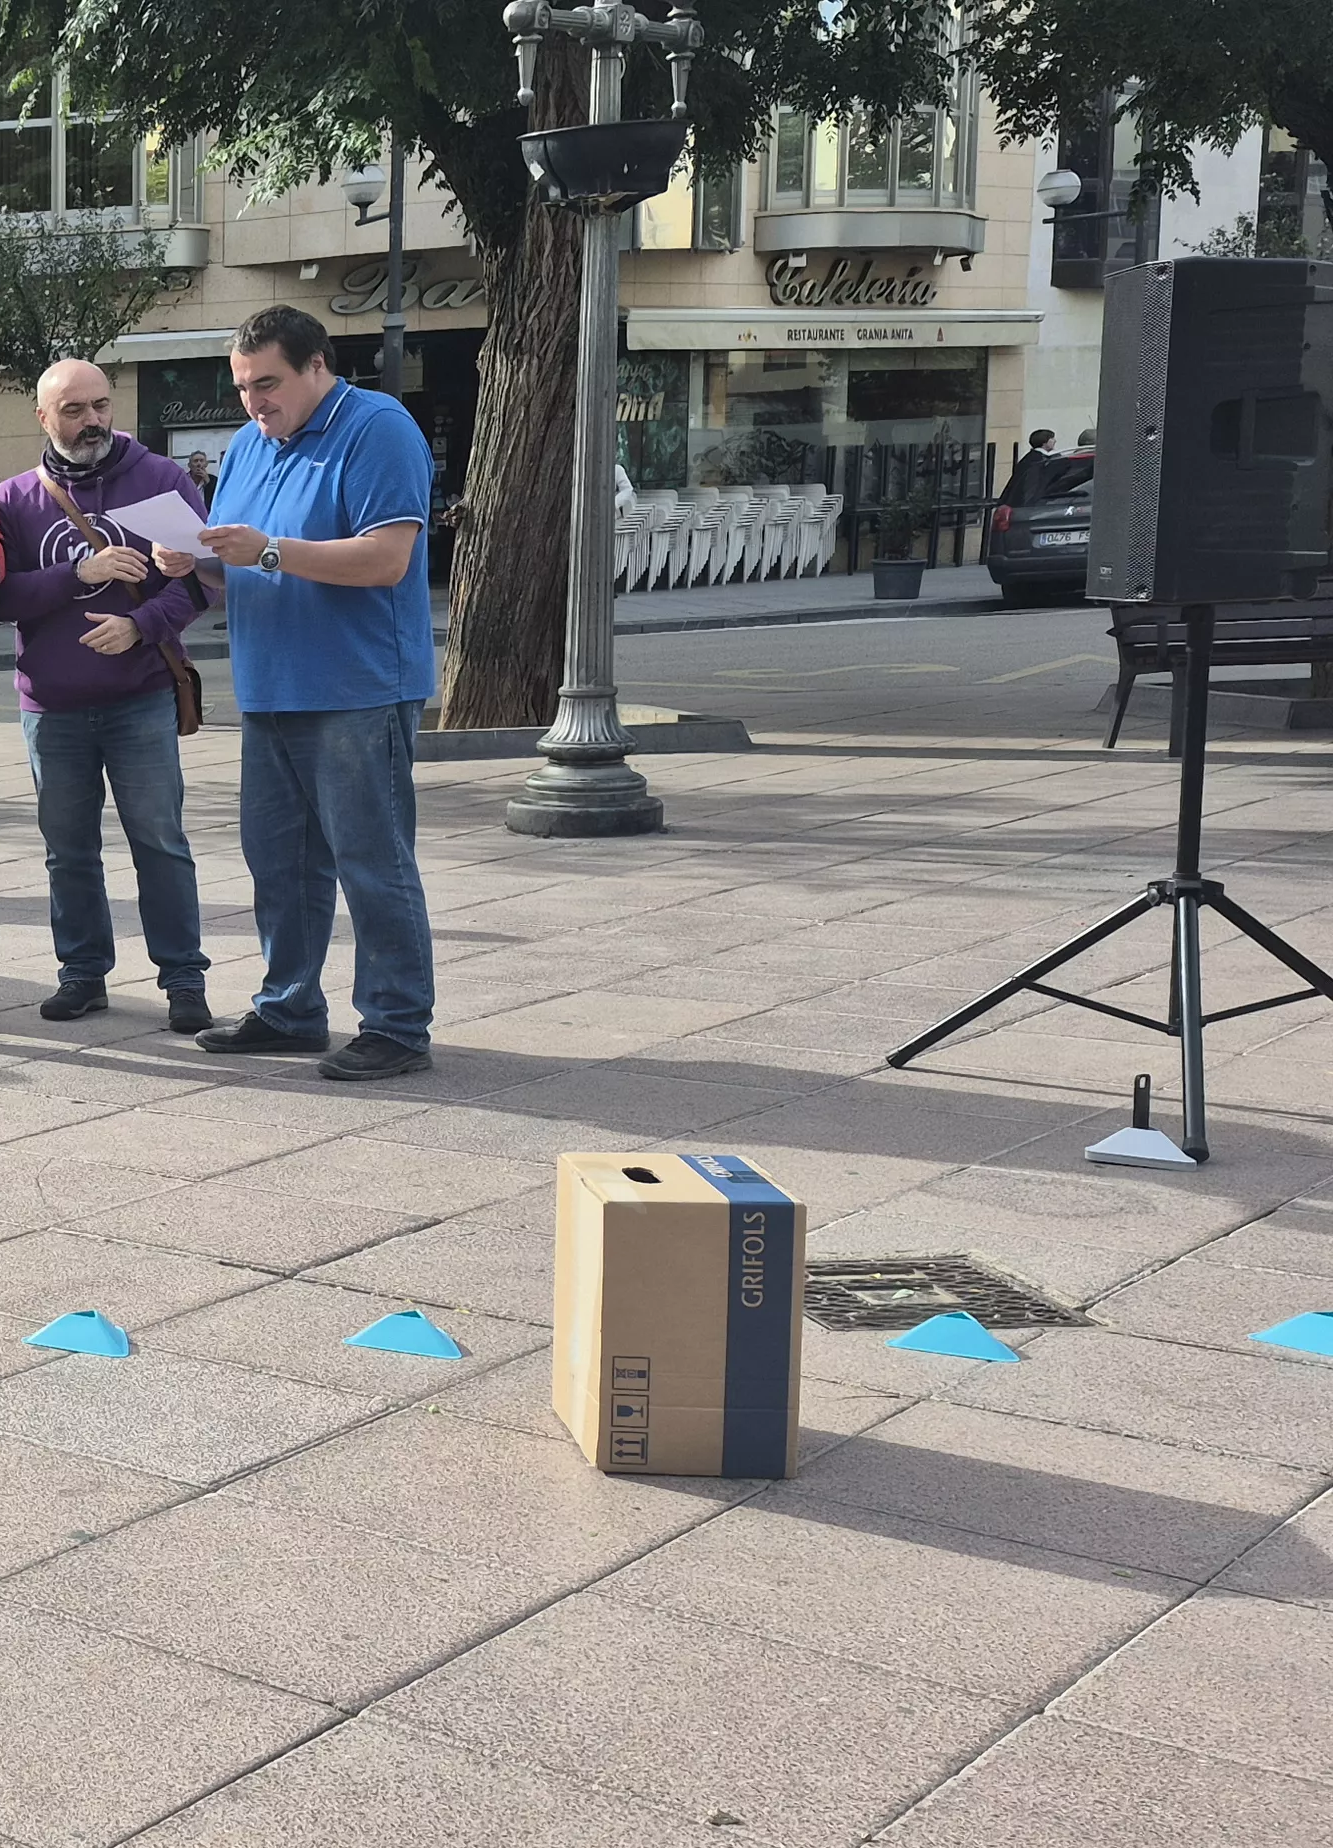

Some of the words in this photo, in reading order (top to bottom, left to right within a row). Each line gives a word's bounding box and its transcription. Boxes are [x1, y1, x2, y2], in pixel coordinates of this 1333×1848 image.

[330, 258, 485, 314] Ba
[766, 258, 936, 307] Cafetería
[787, 329, 845, 341] RESTAURANTE
[857, 328, 888, 341] GRANJA
[891, 328, 913, 341] ANITA
[160, 401, 247, 422] Restaura
[1047, 533, 1071, 543] 0476
[741, 1211, 766, 1308] GRIFOLS
